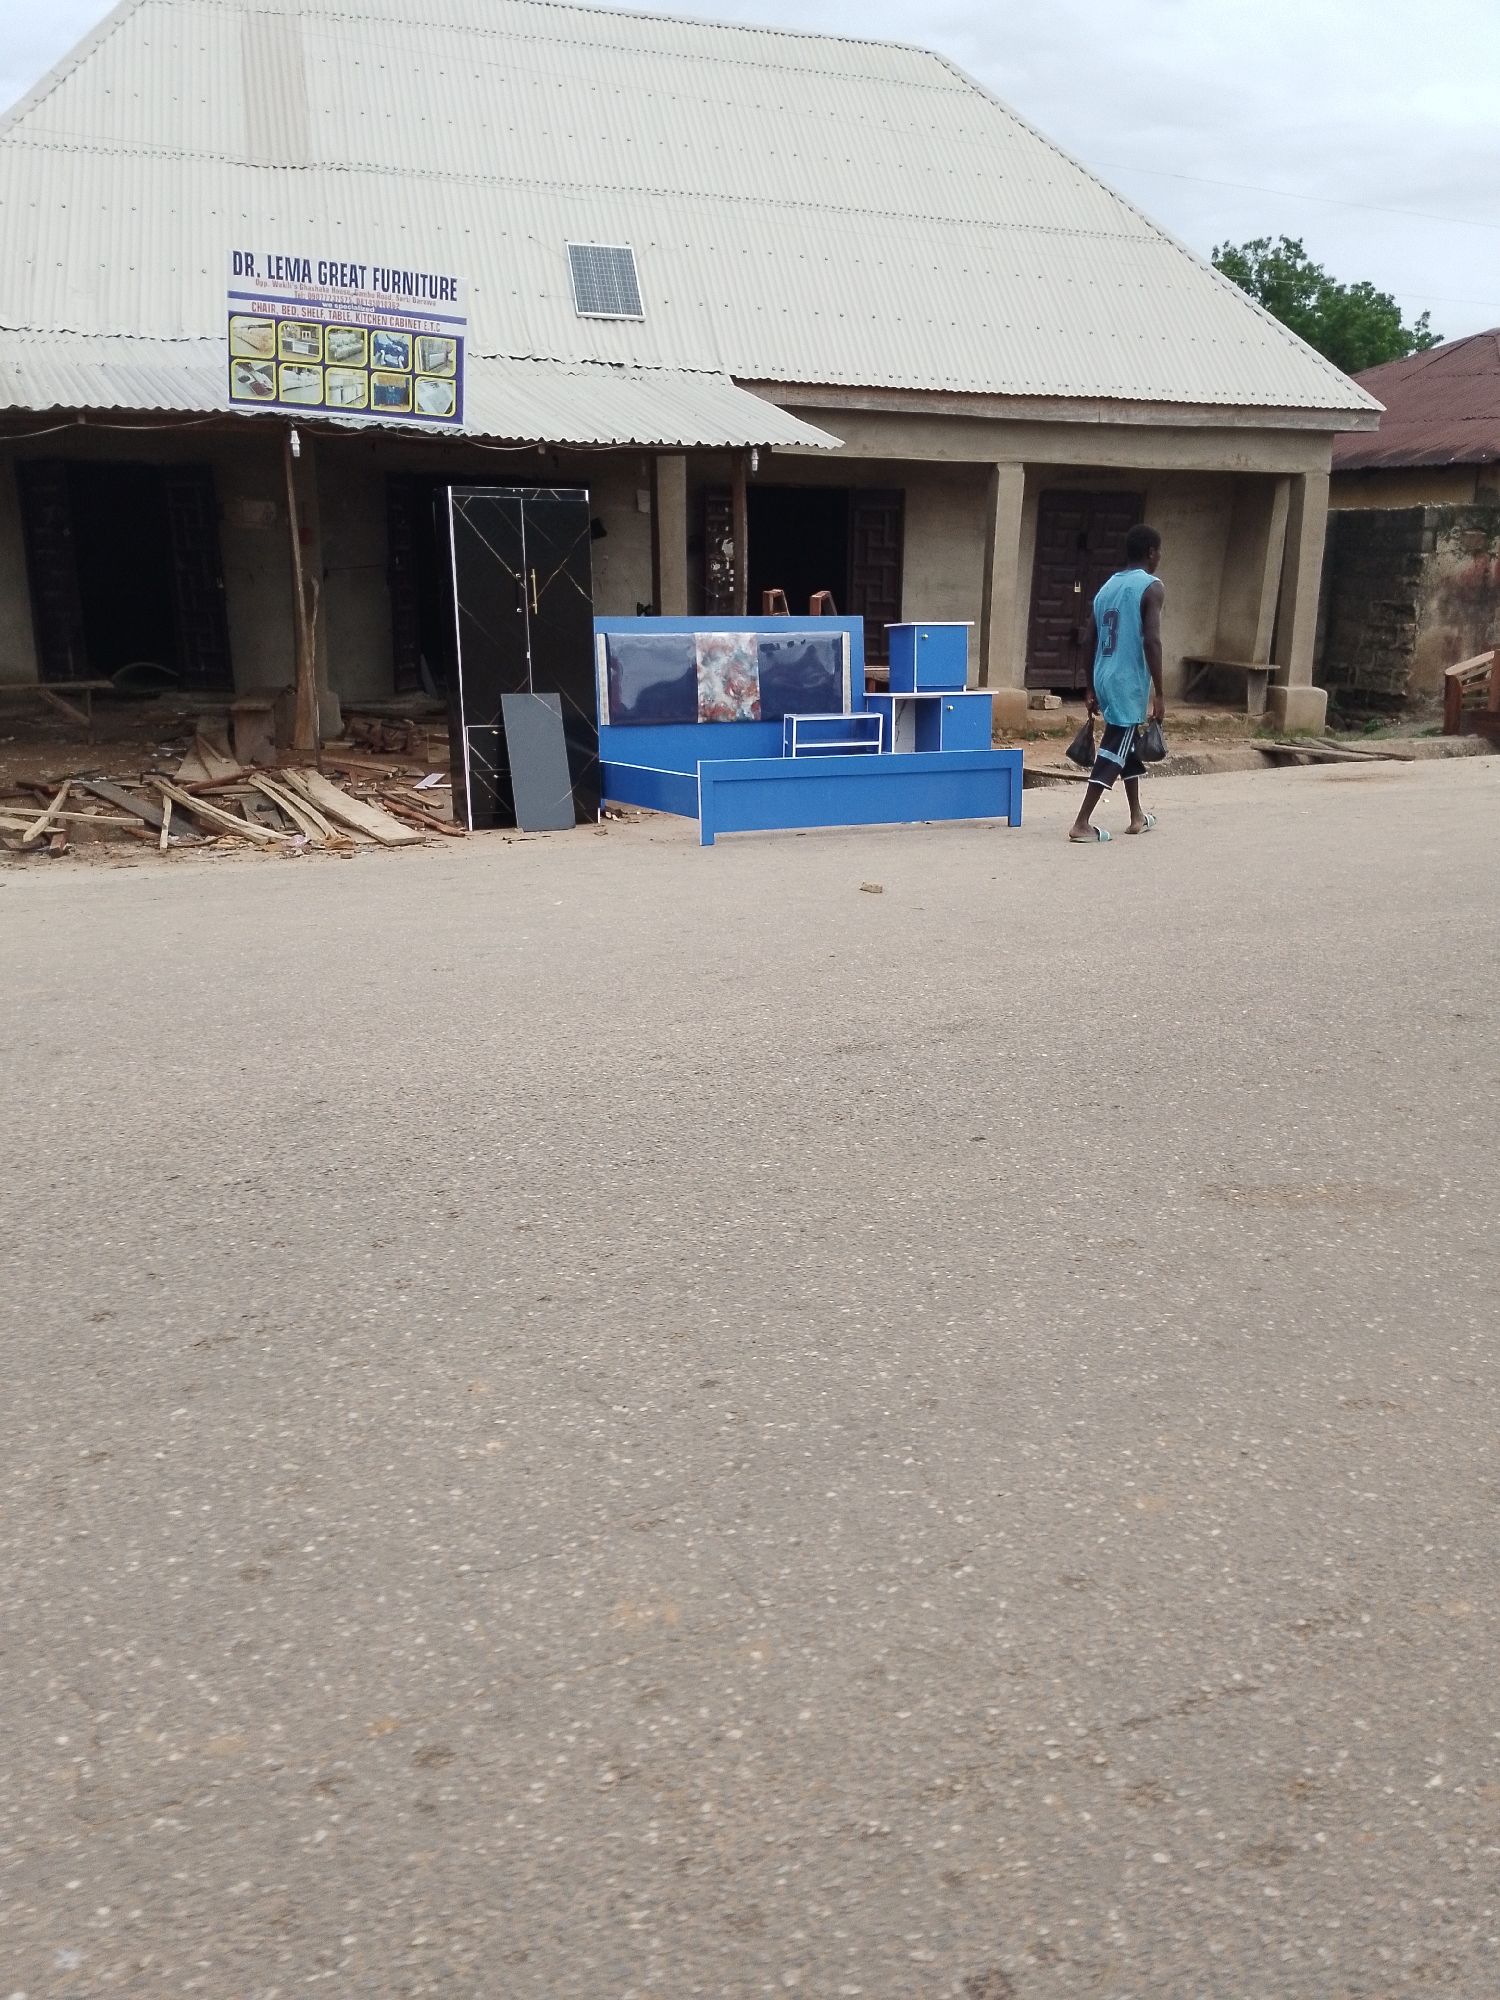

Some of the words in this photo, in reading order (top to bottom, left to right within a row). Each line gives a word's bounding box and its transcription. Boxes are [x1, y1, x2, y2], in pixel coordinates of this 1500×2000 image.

[232, 250, 260, 278] DR.
[268, 254, 312, 283] LEMA
[318, 260, 366, 289] GREAT
[373, 267, 458, 301] FURNITURE
[255, 278, 270, 287] Opp.
[321, 301, 333, 309] we
[334, 302, 375, 313] specialized
[355, 312, 388, 326] KITCHEN
[389, 316, 422, 330] CABINET
